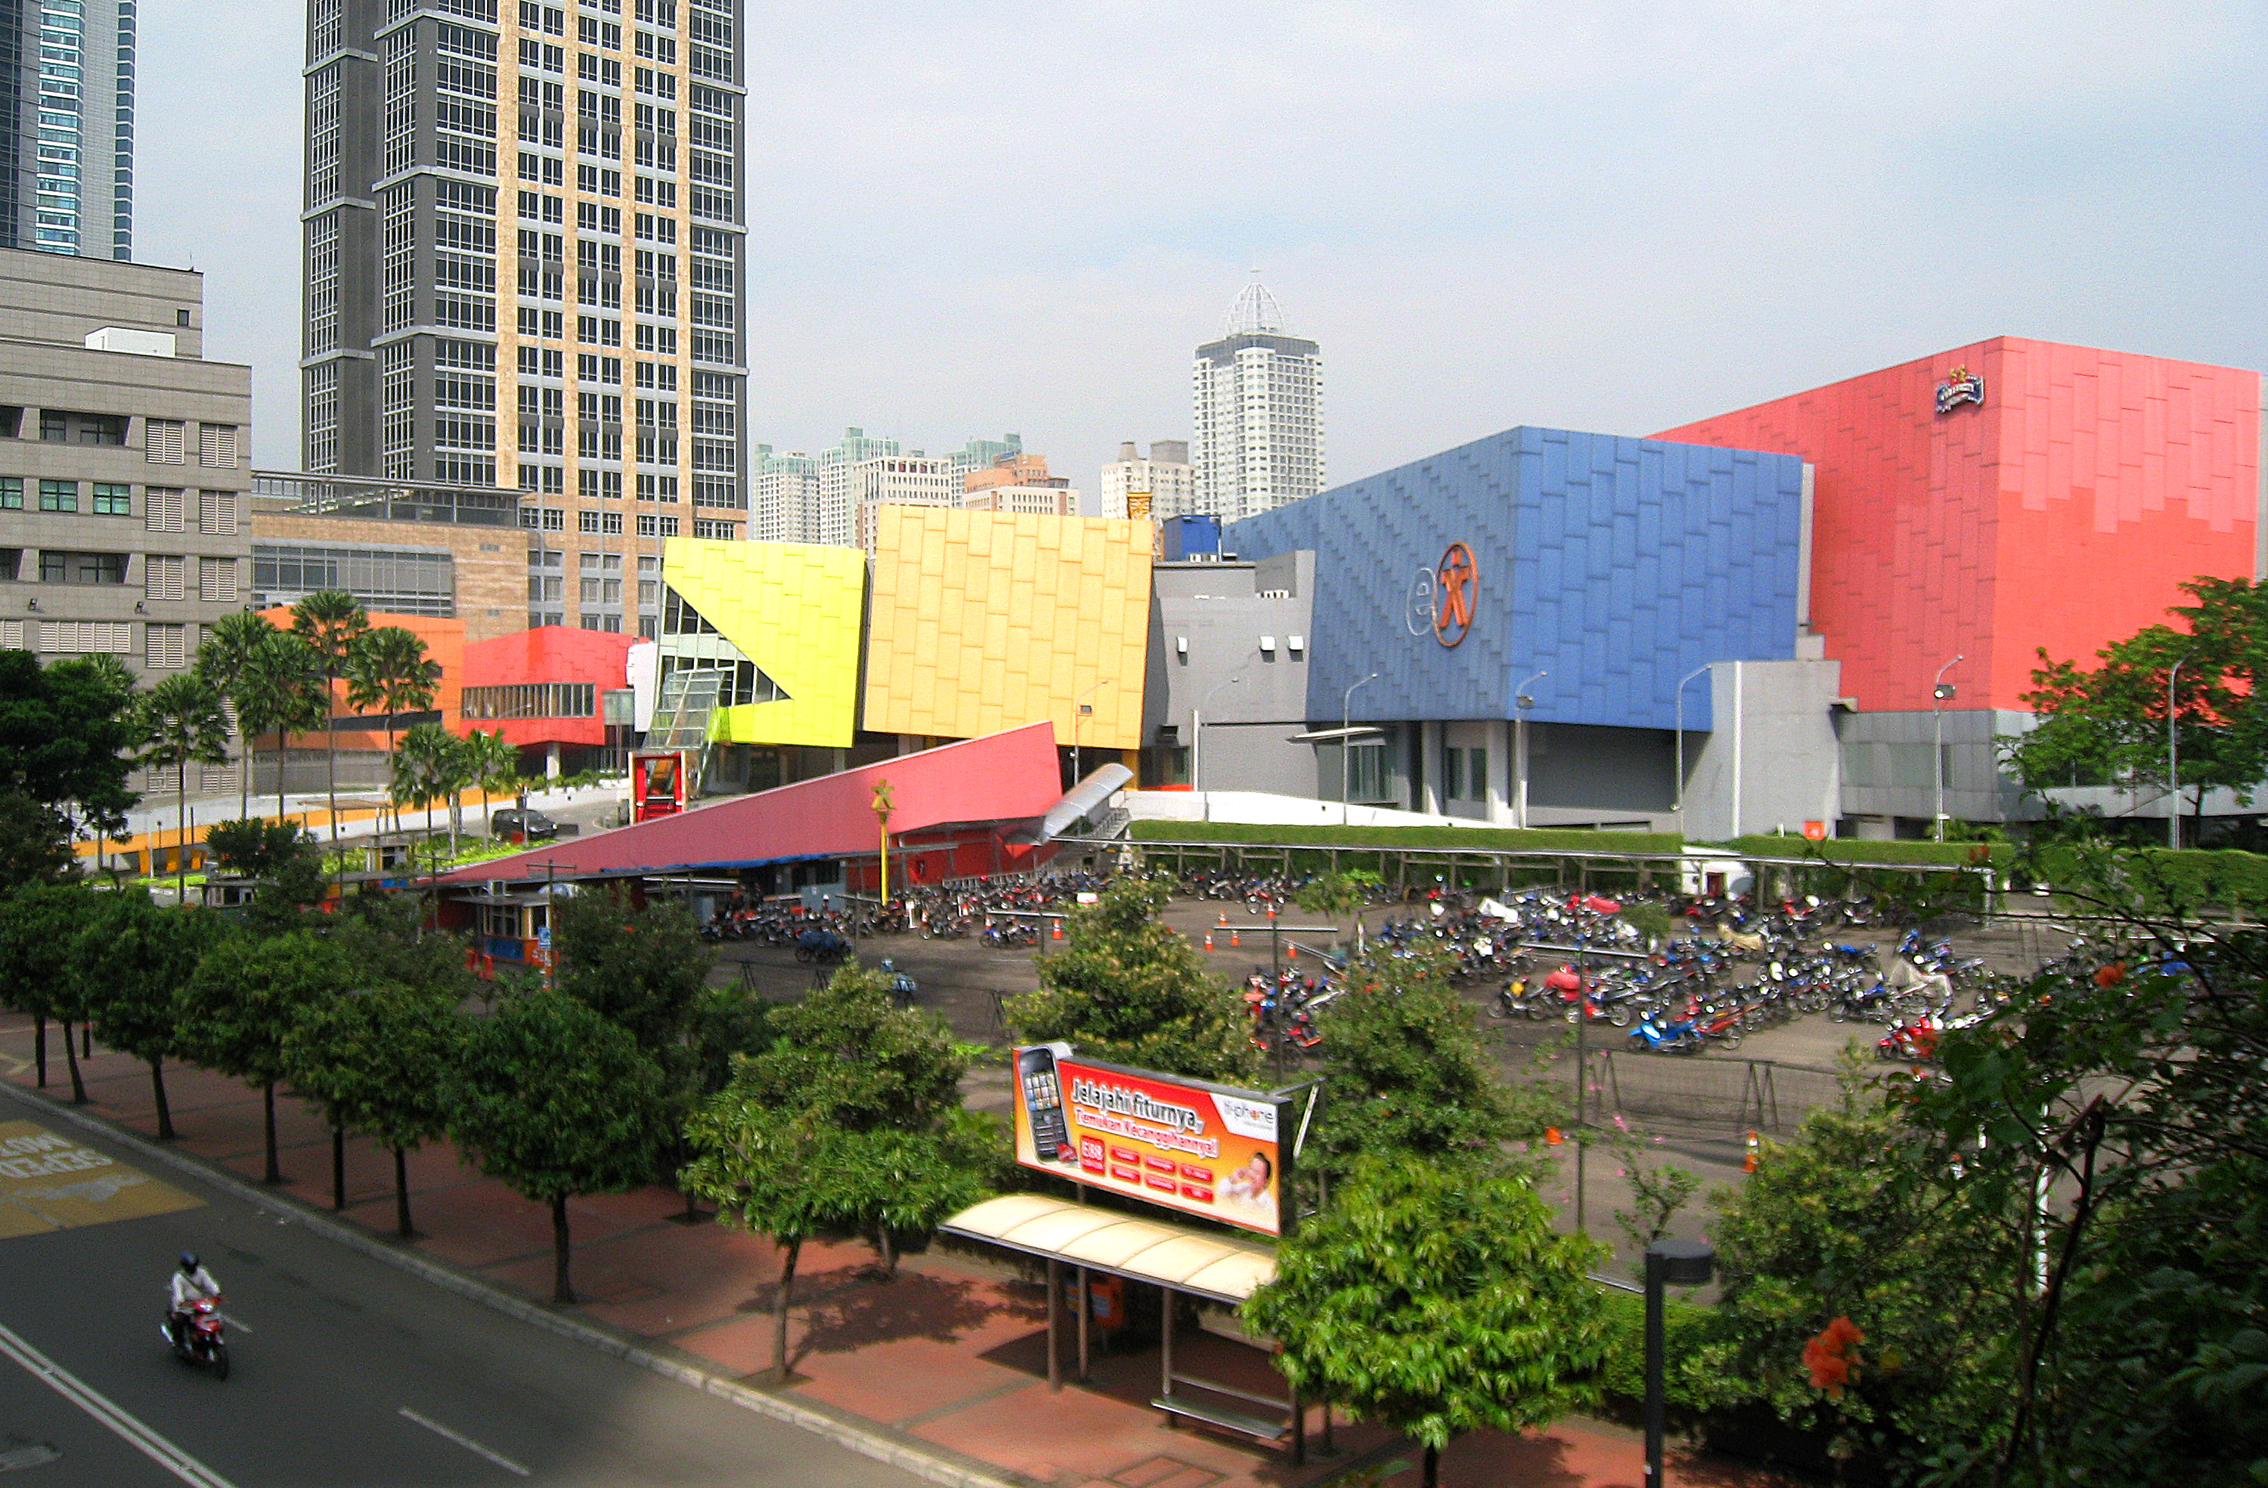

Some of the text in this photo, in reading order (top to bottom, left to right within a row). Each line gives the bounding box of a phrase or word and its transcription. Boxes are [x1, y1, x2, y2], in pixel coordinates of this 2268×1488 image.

[1072, 1078, 1204, 1134] Jelajahi fiturnya,
[1076, 1107, 1121, 1131] Temukan
